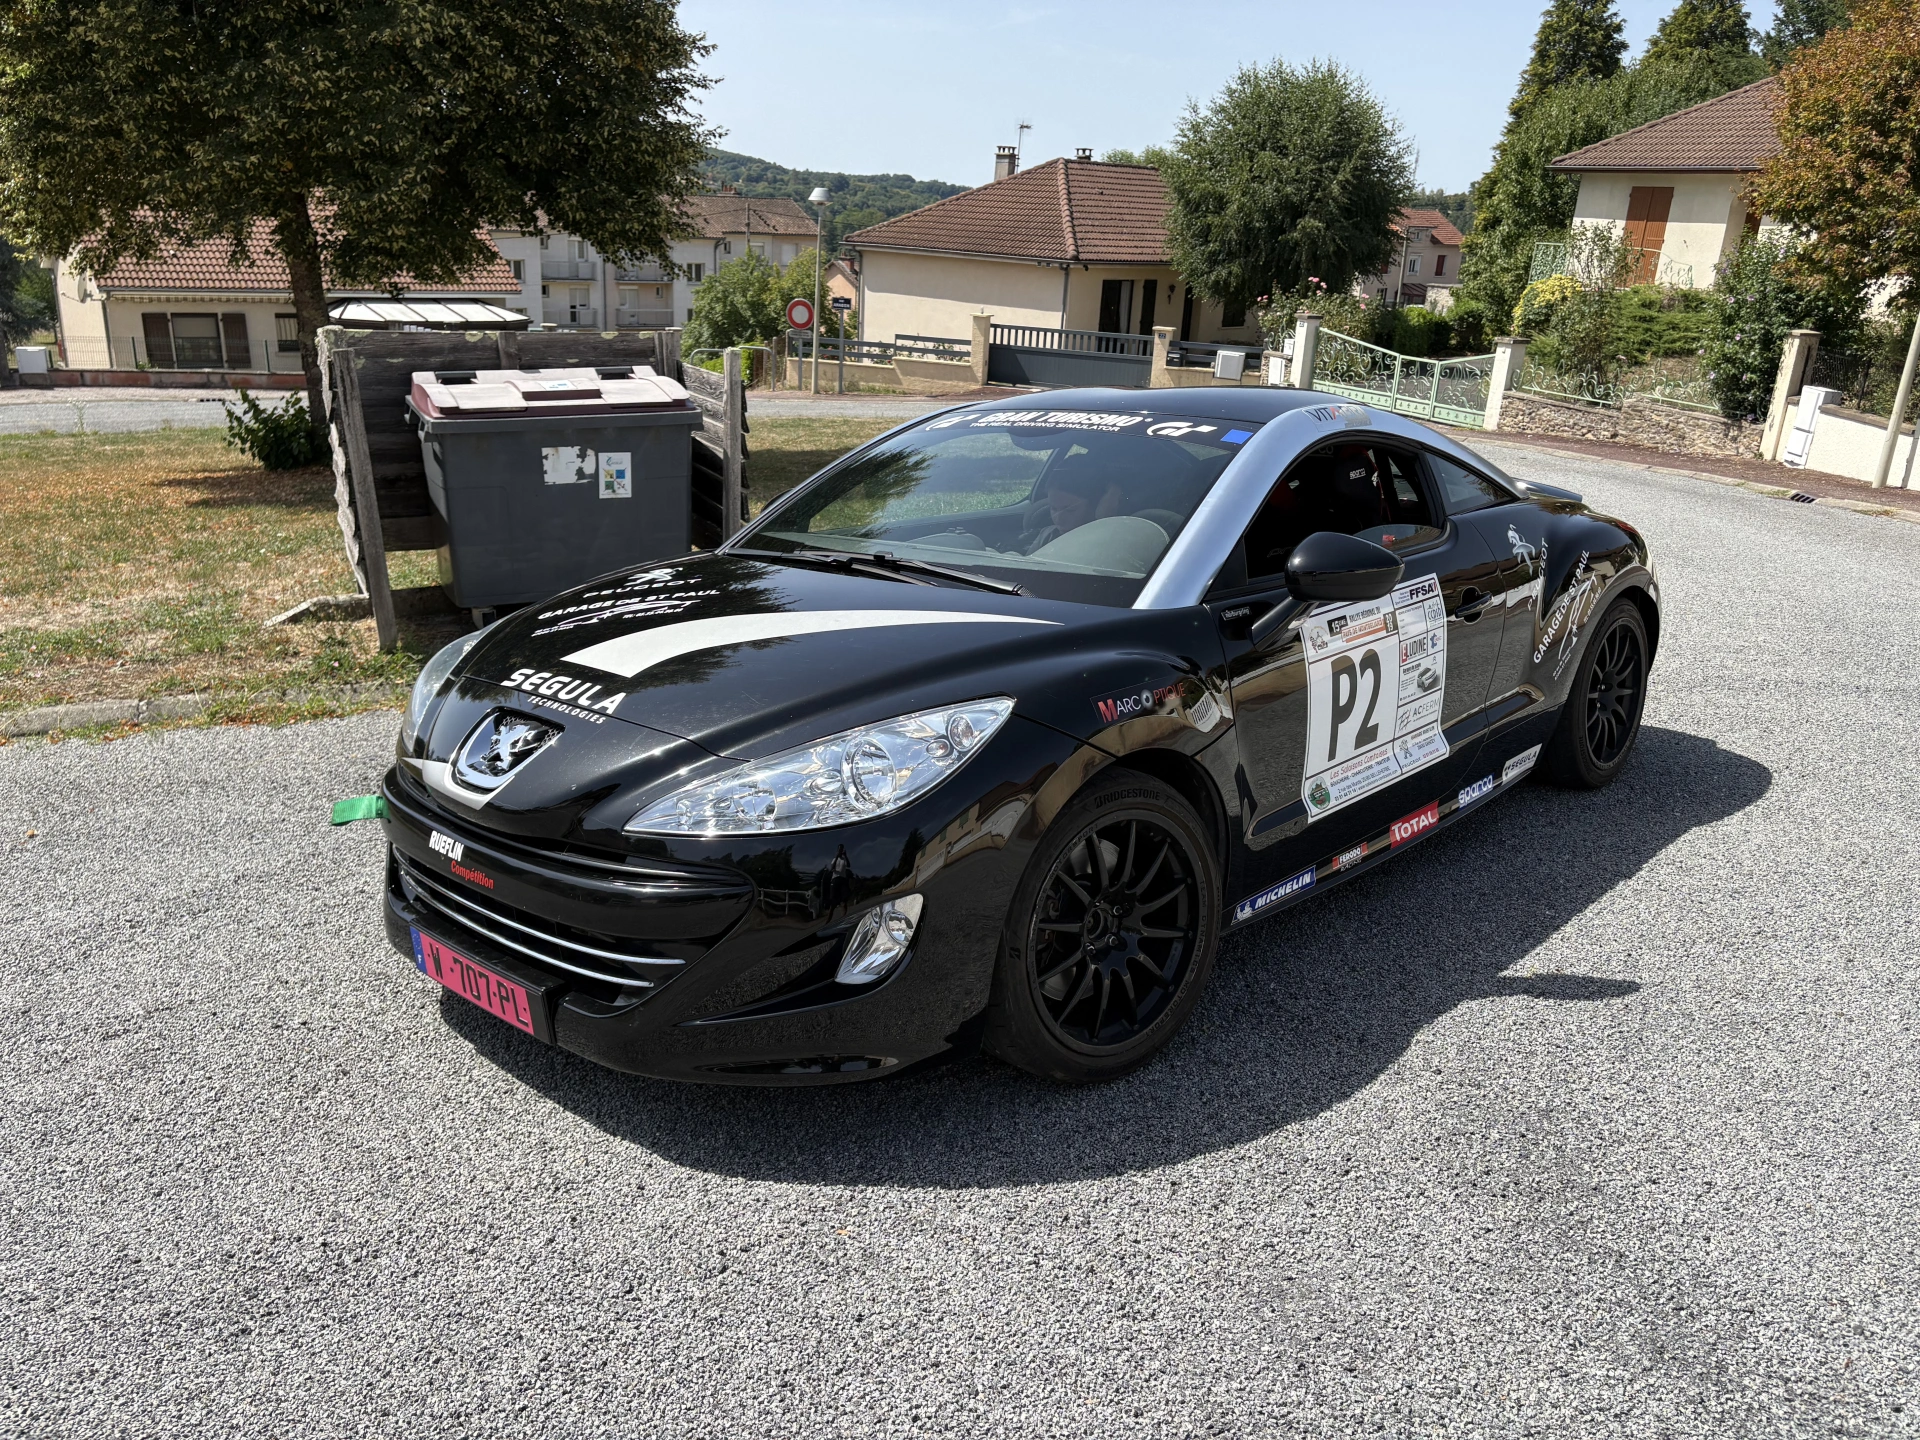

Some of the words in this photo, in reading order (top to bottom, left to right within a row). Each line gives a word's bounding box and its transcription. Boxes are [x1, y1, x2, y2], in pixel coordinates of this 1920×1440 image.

[978, 411, 1045, 423] GRAN
[1055, 423, 1121, 432] SIMULATOR
[583, 579, 701, 598] PEUGEOT
[1528, 537, 1549, 611] PEUGEOT
[537, 600, 615, 620] GARAGE
[615, 597, 642, 606] DE
[644, 593, 670, 602] ST
[671, 589, 721, 599] PAUL
[1409, 582, 1434, 600] FFSA
[1533, 611, 1563, 664] GARAGE
[1559, 594, 1571, 615] DE
[1568, 577, 1578, 595] ST
[1575, 550, 1590, 581] PAUL
[500, 668, 627, 715] SEGULA
[1327, 648, 1382, 763] P2
[527, 695, 607, 725] TECHNOLOGIES
[1097, 693, 1142, 724] MARC
[1094, 788, 1161, 809] BRIDGESTONE
[1458, 774, 1493, 805] sparco
[1391, 810, 1437, 842] TOTAL
[428, 830, 465, 862] RUEFLIN
[1339, 847, 1361, 864] FERODO
[451, 860, 494, 890] Compétition
[1254, 871, 1312, 910] MICHELIN
